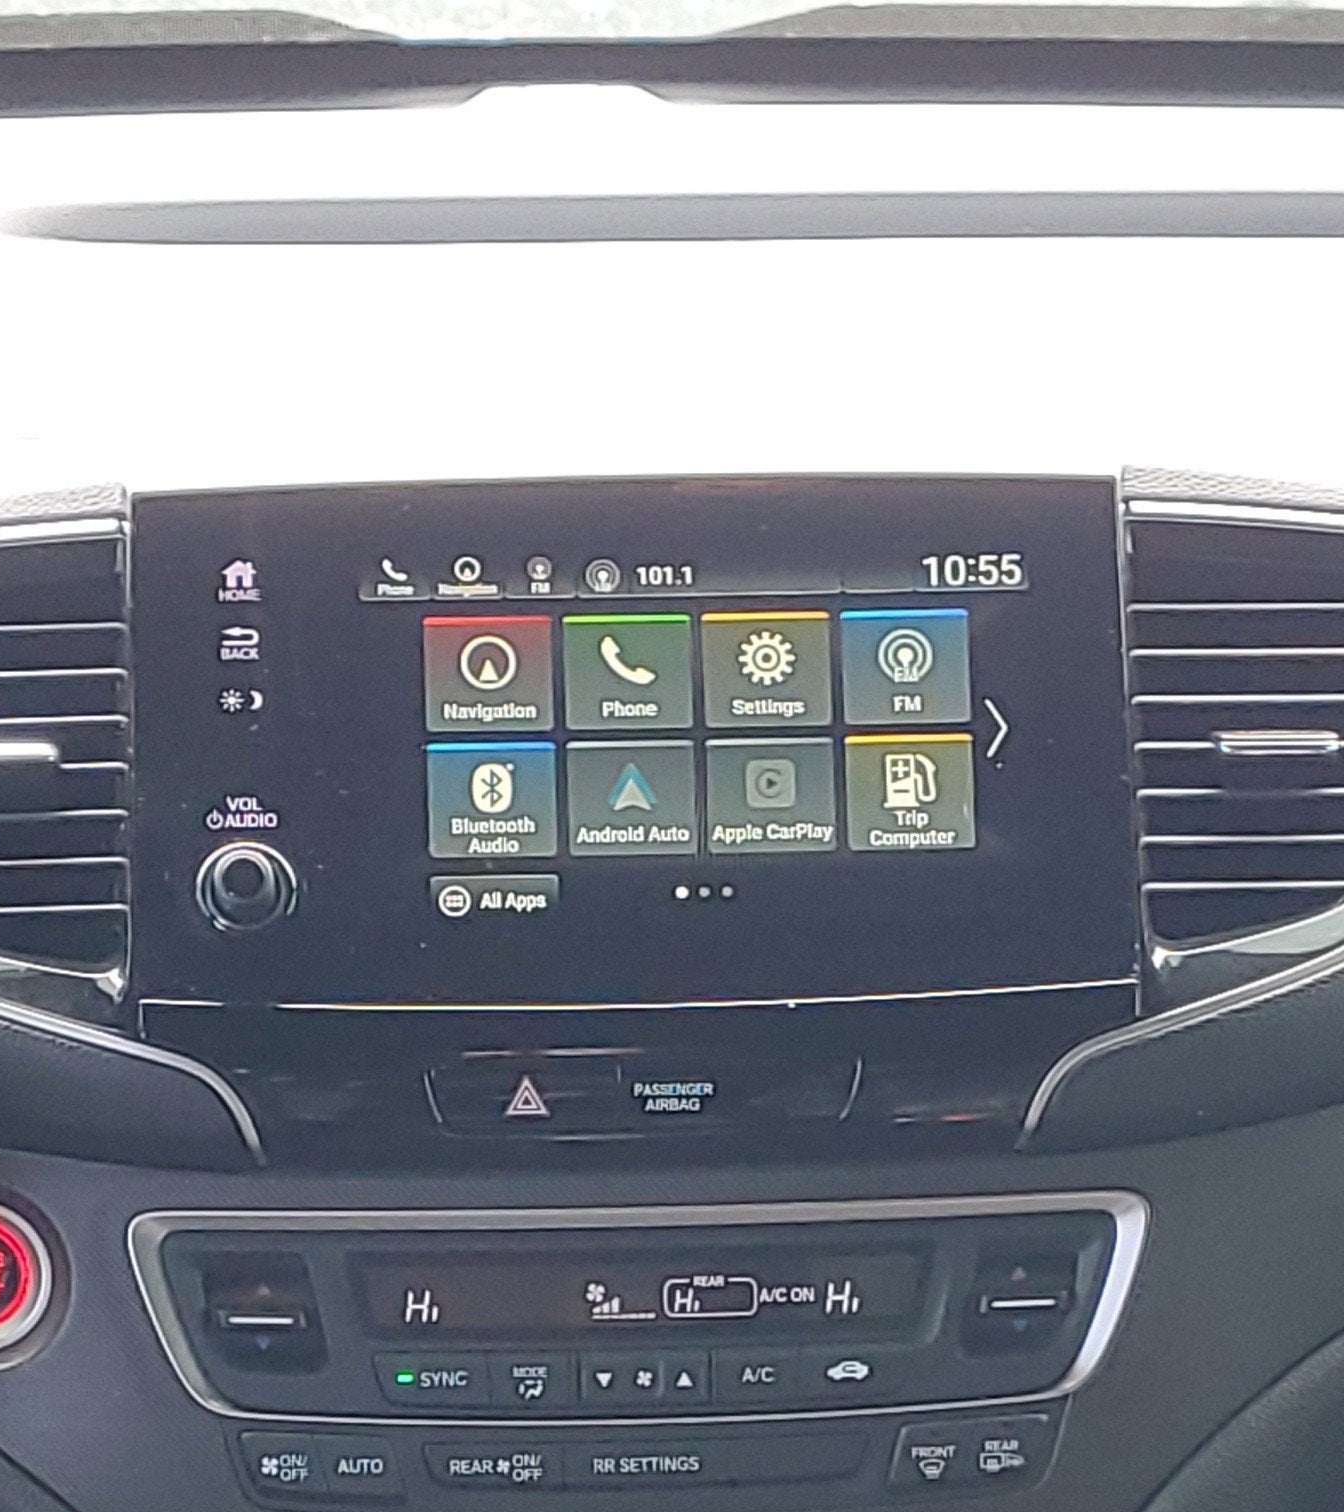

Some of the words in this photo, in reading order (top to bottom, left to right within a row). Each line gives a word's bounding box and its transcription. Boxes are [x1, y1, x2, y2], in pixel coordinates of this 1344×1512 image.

[636, 565, 693, 586] 101.1
[921, 553, 1023, 587] 10:55
[218, 588, 261, 601] HOME
[220, 648, 259, 661] BACK
[443, 702, 538, 722] Navigation
[602, 701, 659, 718] Phone
[731, 699, 806, 717] Settings
[892, 695, 922, 712] FM
[225, 795, 263, 812] VOL
[224, 812, 278, 828] AUDIO
[450, 816, 536, 835] Bluetooth
[894, 811, 930, 829] Trip
[576, 826, 645, 844] Android
[647, 825, 690, 842] Auto
[711, 824, 763, 845] Apple
[766, 822, 834, 843] CarPlay
[869, 830, 956, 849] Computer
[467, 837, 520, 855] Audio
[478, 891, 503, 910] All
[505, 892, 547, 914] Apps
[633, 1082, 714, 1098] PASSENGER
[644, 1097, 701, 1113] AIRBAG
[693, 1276, 725, 1287] REAR
[760, 1287, 788, 1303] A/C
[791, 1287, 816, 1302] ON
[419, 1371, 469, 1388] SYNC
[512, 1366, 548, 1378] MODE
[742, 1367, 775, 1383] A/C
[911, 1445, 956, 1458] FRONT
[984, 1440, 1019, 1452] REAR
[338, 1459, 384, 1474] AUTO
[449, 1459, 495, 1476] REAR
[593, 1458, 615, 1474] RR
[620, 1456, 700, 1474] SETTINGS
[280, 1469, 309, 1482] OFF
[512, 1468, 543, 1482] OFF
